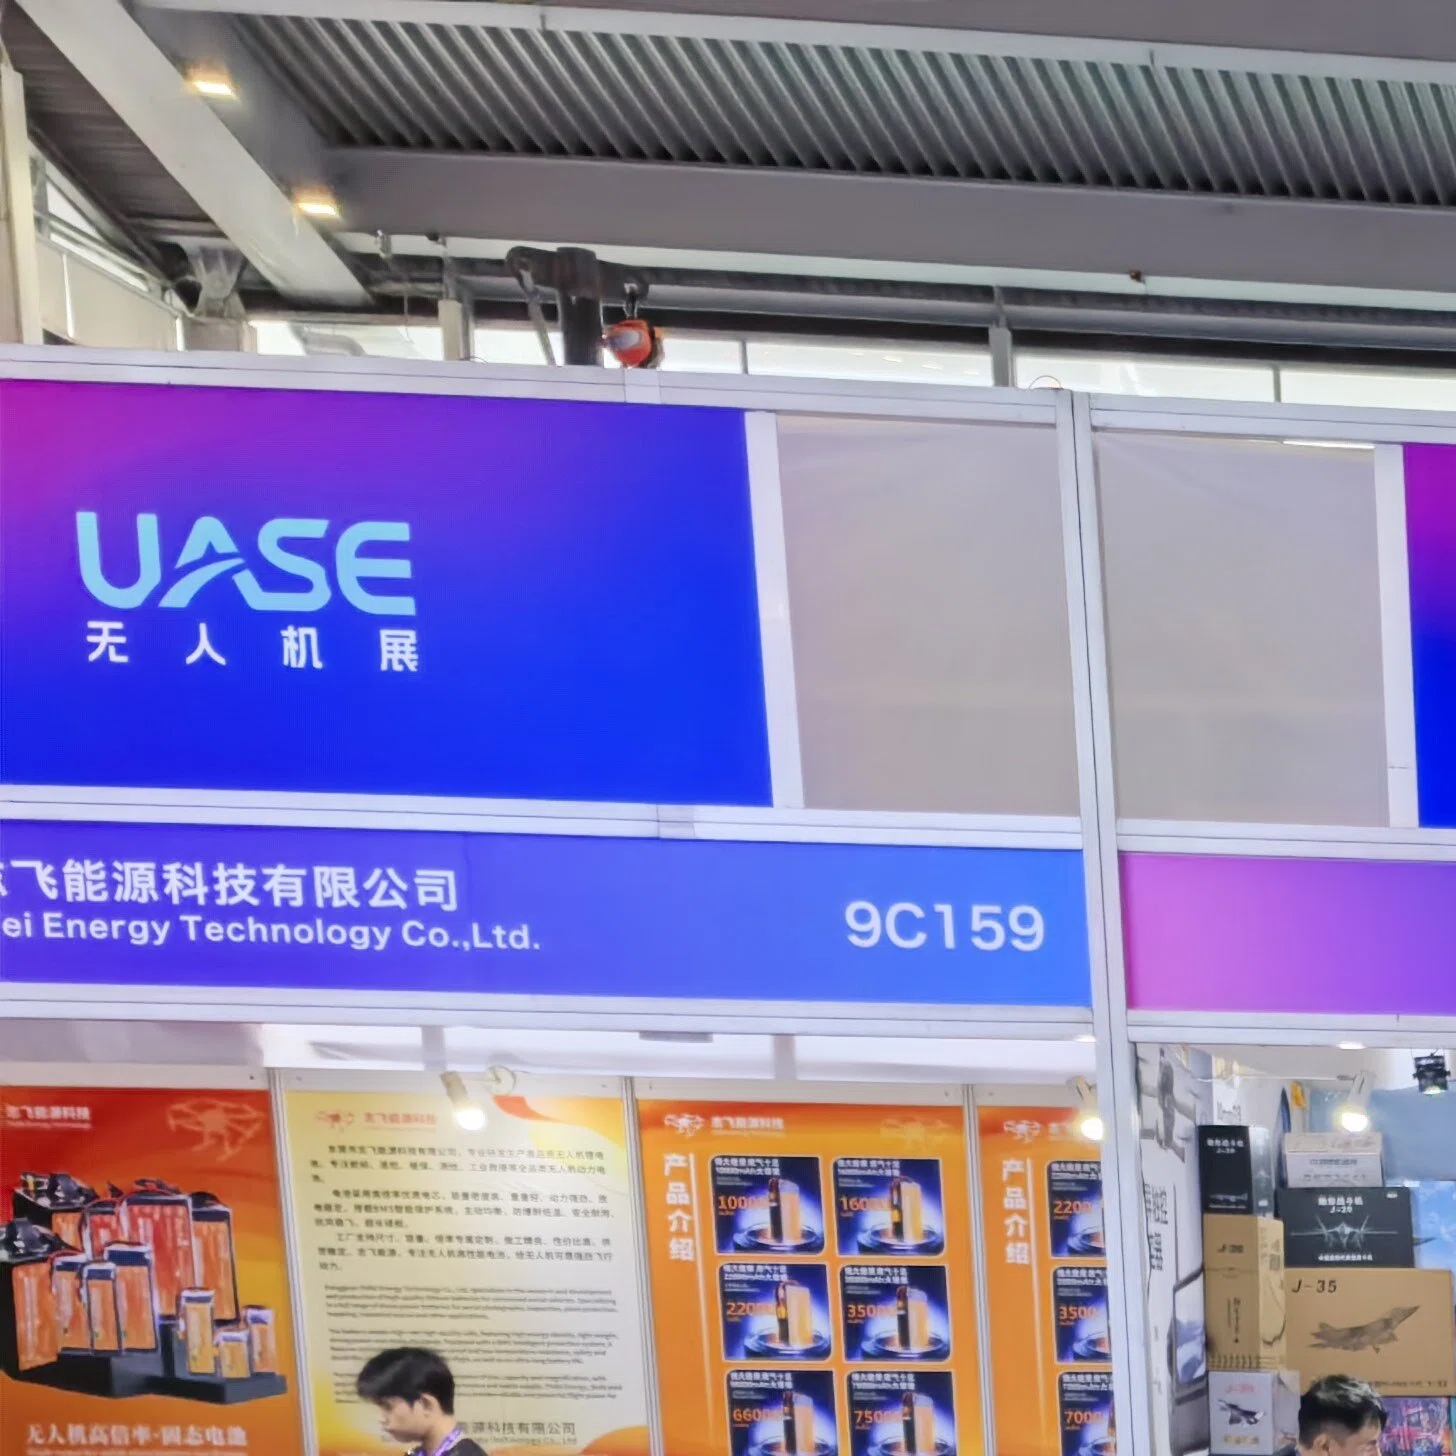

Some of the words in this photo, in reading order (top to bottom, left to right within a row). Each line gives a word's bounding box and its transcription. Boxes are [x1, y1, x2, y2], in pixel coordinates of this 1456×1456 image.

[75, 511, 417, 616] UASE
[85, 620, 420, 674] 无人机展
[0, 859, 459, 912] 飞能源科技有限公司
[43, 912, 170, 945] Energy
[179, 914, 392, 951] Technology
[401, 920, 540, 951] Co.,Ltd.
[844, 901, 1046, 953] 9C159
[663, 1152, 695, 1262] 产品介绍
[1002, 1159, 1030, 1265] 产品介绍
[1292, 1279, 1337, 1294] J-35
